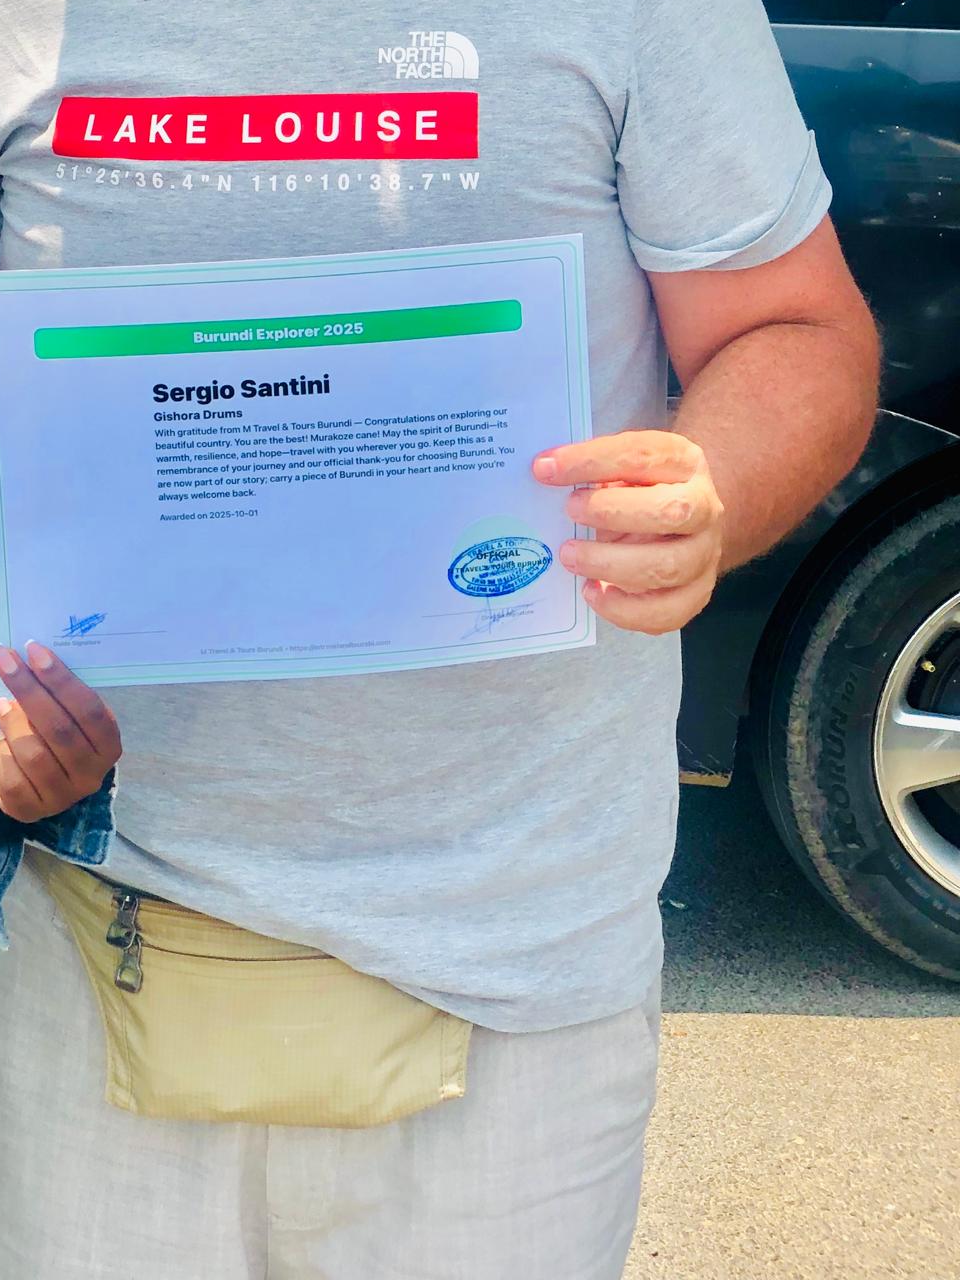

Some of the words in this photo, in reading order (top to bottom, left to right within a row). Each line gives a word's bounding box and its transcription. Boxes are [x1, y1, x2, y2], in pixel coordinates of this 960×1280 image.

[408, 31, 445, 47] THE
[378, 46, 444, 64] NORTH
[395, 62, 443, 80] FACE
[83, 113, 207, 144] LAKE
[241, 110, 439, 144] LOUISE
[193, 329, 253, 344] Burundi
[256, 325, 320, 342] Explorer
[323, 322, 364, 337] 2025
[152, 379, 235, 405] Sergio
[240, 373, 330, 399] Santini
[153, 411, 201, 422] Gishora
[203, 409, 243, 420] Drums
[155, 429, 175, 437] With
[177, 426, 218, 438] gratitude
[220, 426, 240, 434] from
[253, 424, 280, 433] Travel
[282, 423, 288, 431] &
[291, 422, 315, 431] Tours
[318, 419, 352, 429] Burundi
[364, 414, 435, 428] Congratulations
[450, 409, 491, 422] exploring
[493, 408, 508, 416] our
[156, 440, 194, 450] beautiful
[197, 440, 232, 450] country.
[234, 438, 251, 446] You
[269, 436, 284, 444] the
[286, 435, 308, 443] best!
[310, 432, 353, 442] Murakoze
[356, 431, 380, 440] cane!
[382, 430, 401, 439] May
[403, 428, 417, 436] the
[419, 426, 442, 436] spirit
[444, 425, 453, 433] of
[455, 421, 508, 432] Burundi—its
[156, 454, 192, 463] warmth,
[194, 452, 239, 462] resilience,
[241, 450, 257, 459] and
[259, 447, 315, 458] hope—travel
[317, 446, 336, 455] with
[337, 446, 354, 454] you
[356, 442, 397, 452] wherever
[399, 442, 416, 451] you
[418, 441, 432, 450] go.
[433, 439, 456, 448] Keep
[457, 436, 473, 444] this
[475, 436, 486, 444] as
[157, 466, 218, 476] remembrance
[221, 464, 230, 472] of
[232, 464, 252, 474] your
[253, 462, 286, 472] journey
[288, 461, 305, 469] and
[307, 460, 321, 468] our
[324, 457, 354, 466] official
[356, 454, 401, 465] thank-you
[403, 454, 415, 462] for
[417, 451, 458, 462] choosing
[460, 448, 496, 458] Burundi.
[498, 446, 515, 454] You
[194, 478, 212, 488] part
[214, 478, 223, 486] of
[242, 476, 268, 485] story;
[270, 474, 292, 483] carry
[302, 472, 326, 482] piece
[328, 471, 337, 479] of
[340, 470, 375, 479] Burundi
[376, 469, 384, 477] in
[386, 468, 406, 477] your
[408, 466, 432, 474] heart
[433, 464, 450, 473] and
[452, 462, 476, 471] know
[158, 492, 188, 502] always
[191, 490, 230, 499] welcome
[232, 488, 256, 497] back.
[160, 512, 195, 521] Awarded
[197, 512, 207, 520] on
[209, 509, 258, 519] 2025-10-01
